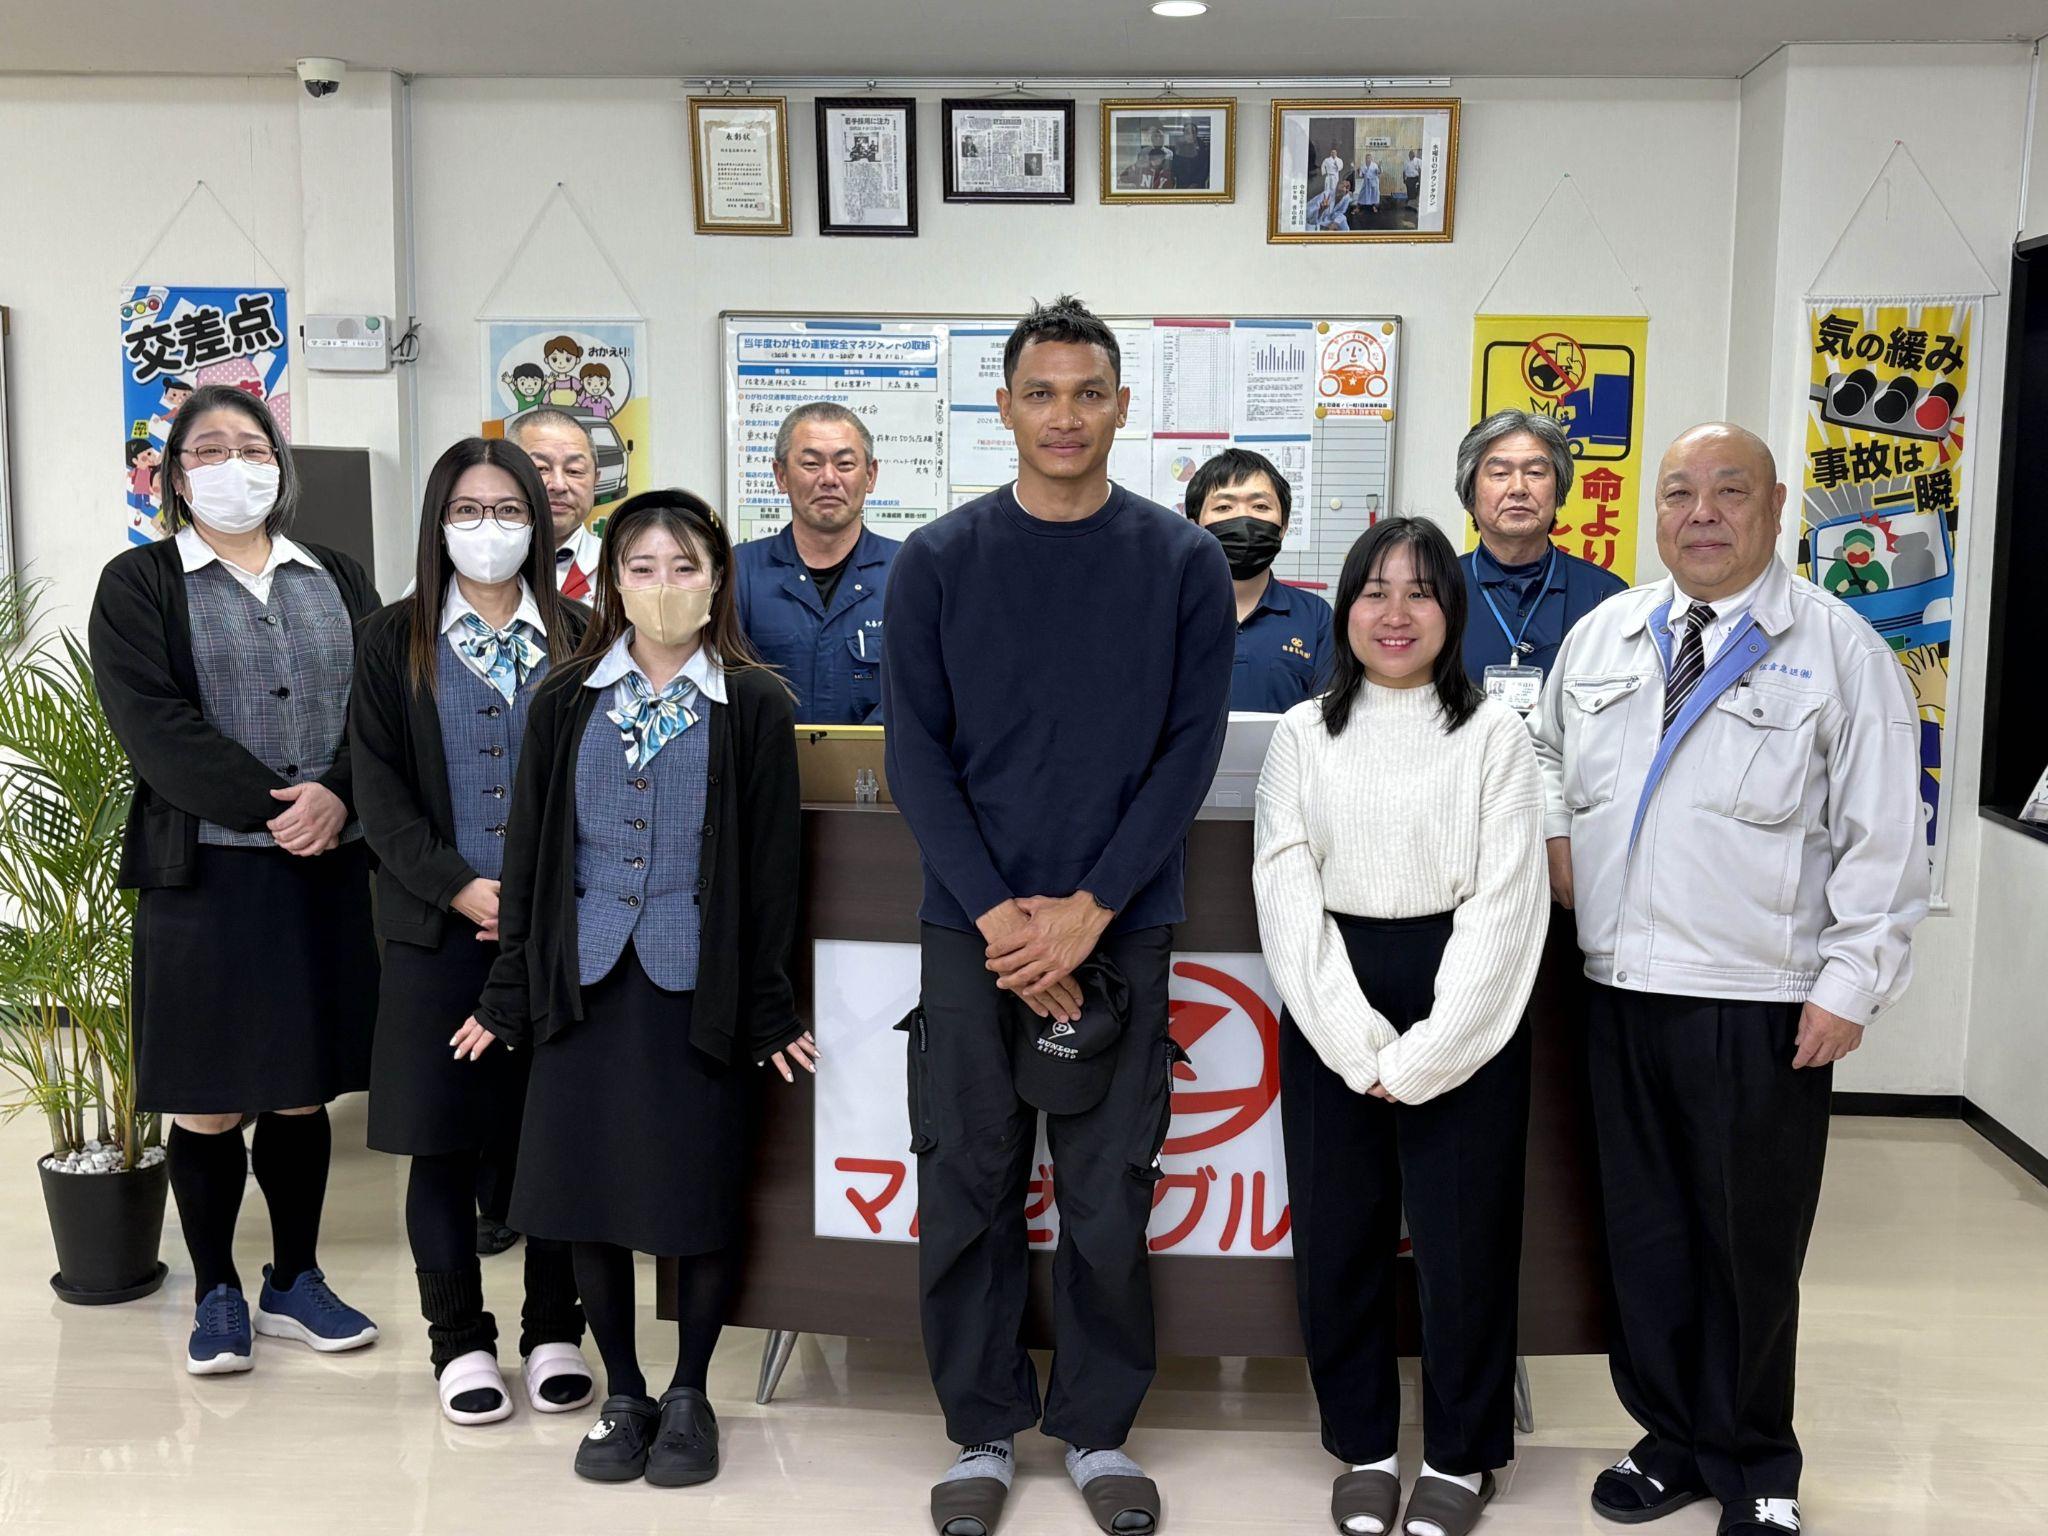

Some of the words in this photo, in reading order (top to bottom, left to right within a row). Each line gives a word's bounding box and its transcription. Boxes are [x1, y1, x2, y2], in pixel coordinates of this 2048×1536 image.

[726, 132, 751, 141] 表彰状
[1429, 144, 1439, 206] 水曜日のダウンタウン
[125, 296, 280, 379] 交差点
[1815, 314, 1965, 376] 気の緩み
[1811, 440, 1925, 488] 事故は
[1874, 468, 1953, 512] 一瞬
[1580, 467, 1625, 570] 命より
[1037, 1037, 1079, 1055] DUNLOP
[1037, 1045, 1077, 1060] REFINED
